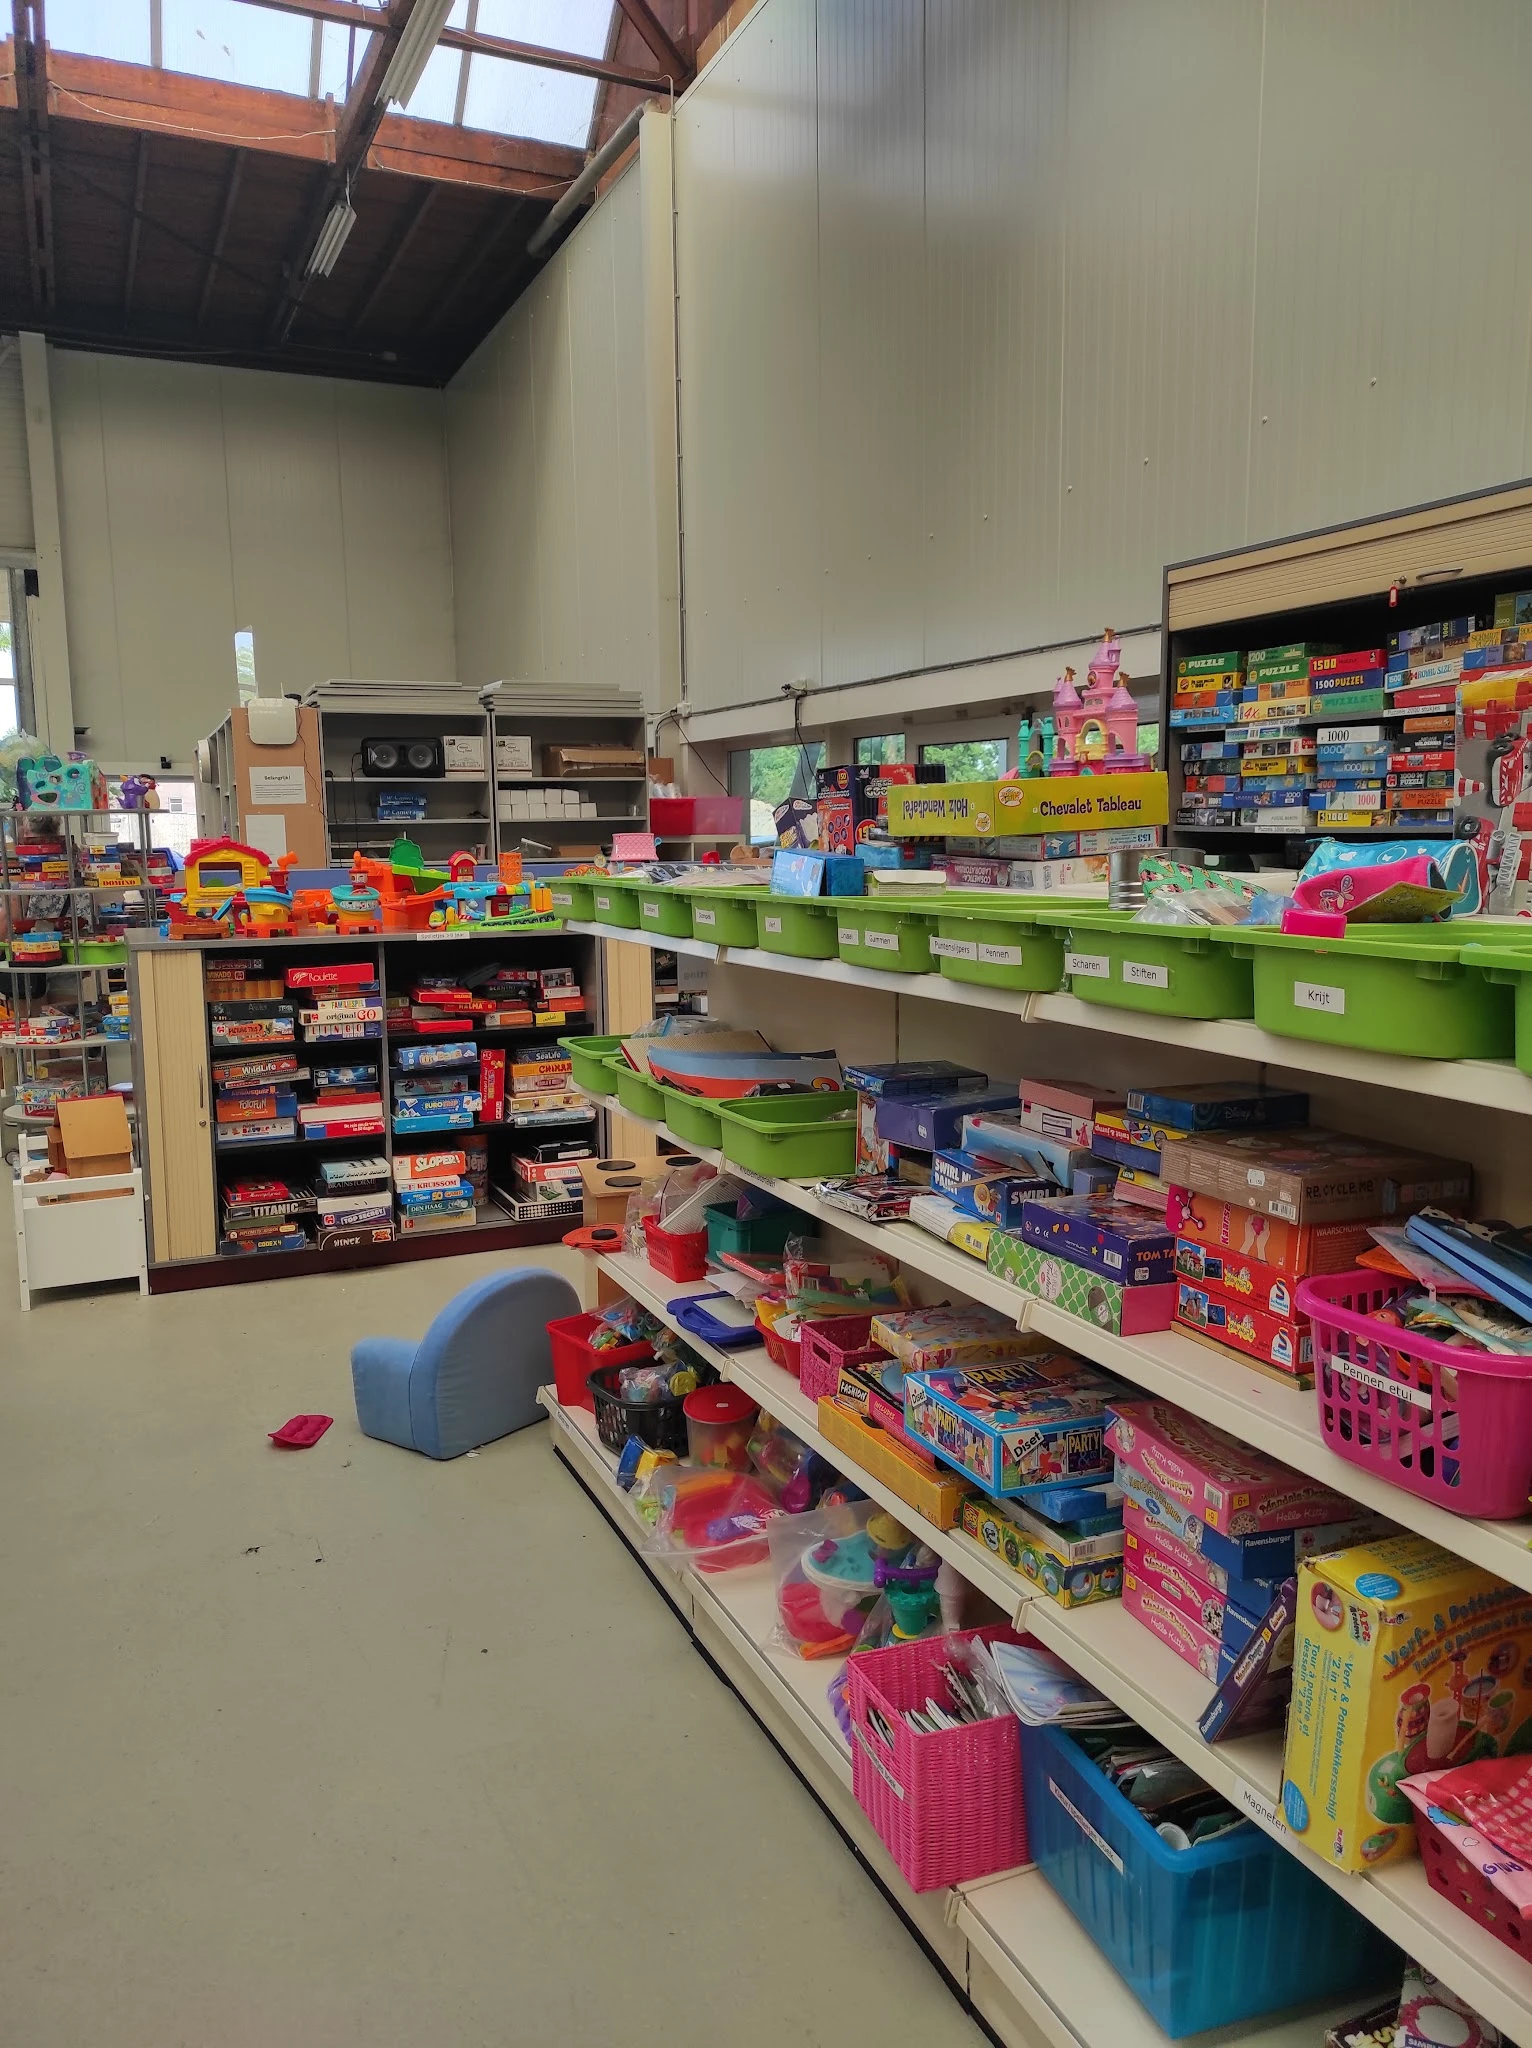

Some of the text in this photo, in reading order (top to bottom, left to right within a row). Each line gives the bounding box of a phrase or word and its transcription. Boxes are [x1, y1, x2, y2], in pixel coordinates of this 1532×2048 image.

[1188, 657, 1225, 669] PUZZLE
[1312, 658, 1337, 671] 1500
[1259, 664, 1300, 677] PUZZLE
[1315, 679, 1335, 690] 1500
[1328, 729, 1350, 742] 1000
[1320, 745, 1343, 755] 1000
[1343, 763, 1362, 772] 1000
[1358, 794, 1376, 805] 1000
[903, 798, 968, 821] Wandtafel Holz
[1039, 796, 1142, 817] Chevalet Tableau
[1327, 813, 1349, 822] 1000
[102, 878, 136, 887] DOMINO
[868, 934, 891, 946] Gummen
[985, 948, 1010, 959] Pennen
[1072, 958, 1101, 971] Scharen
[308, 972, 338, 983] Roulette
[1131, 966, 1157, 981] Stiften
[1307, 988, 1331, 1005] Krijt
[326, 1009, 377, 1022] original GO
[535, 1051, 561, 1061] SeaLife
[241, 1062, 277, 1074] WildLife
[1094, 1125, 1111, 1133] jump
[935, 1158, 960, 1181] SWIRL
[253, 1203, 300, 1217] TITANIC
[411, 1202, 443, 1213] DEN HAAG
[1136, 1250, 1161, 1262] TOM
[966, 1364, 1035, 1385] PARTY
[1343, 1362, 1413, 1402] Pennen etui
[841, 1381, 868, 1402] FASHION
[912, 1389, 926, 1404] Diset
[874, 1401, 896, 1420] INCLUDES
[937, 1409, 956, 1436] PARTY
[1013, 1431, 1041, 1458] Diset
[1069, 1431, 1100, 1453] PARTY
[1236, 1496, 1247, 1508] 6+
[1244, 1534, 1291, 1548] Ravensburger
[1154, 1533, 1194, 1567] Hello Kitty
[1150, 1616, 1186, 1653] Hello Kitty
[1330, 1670, 1340, 1683] in
[1302, 1643, 1320, 1737] Tour à poterie et
[1340, 1693, 1350, 1703] &
[1326, 1706, 1348, 1821] Pottebakkersschijf
[1243, 1789, 1288, 1835] Magneten
